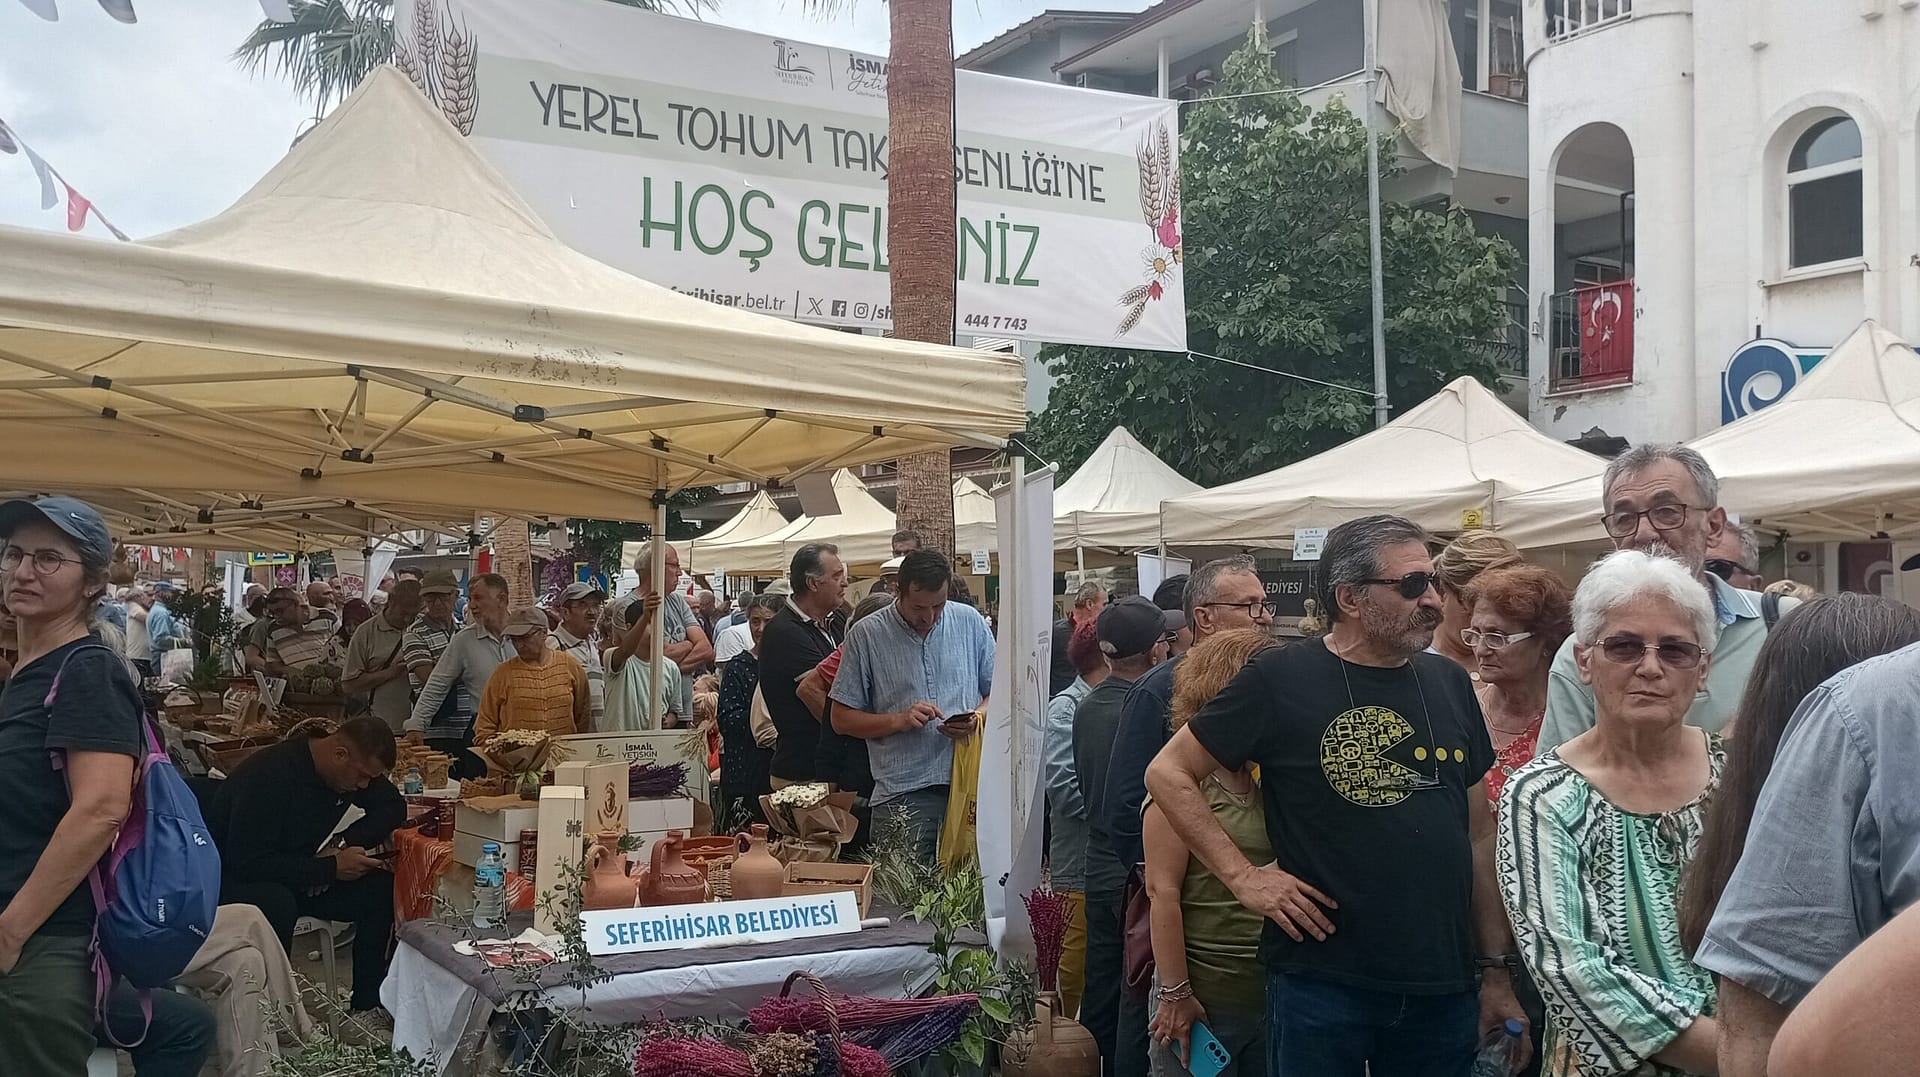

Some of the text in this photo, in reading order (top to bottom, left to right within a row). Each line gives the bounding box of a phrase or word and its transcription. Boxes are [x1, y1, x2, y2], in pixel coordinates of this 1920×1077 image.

[529, 80, 659, 141] YEREL
[667, 102, 813, 164] TOHUM
[823, 126, 888, 179] TAK
[639, 176, 1041, 287] HOŞ GELNİZ
[964, 313, 1028, 331] 444 7 743
[1262, 578, 1303, 594] EDİYESİ
[605, 899, 839, 946] SEFERİHİSAR BELEDİYESİ
